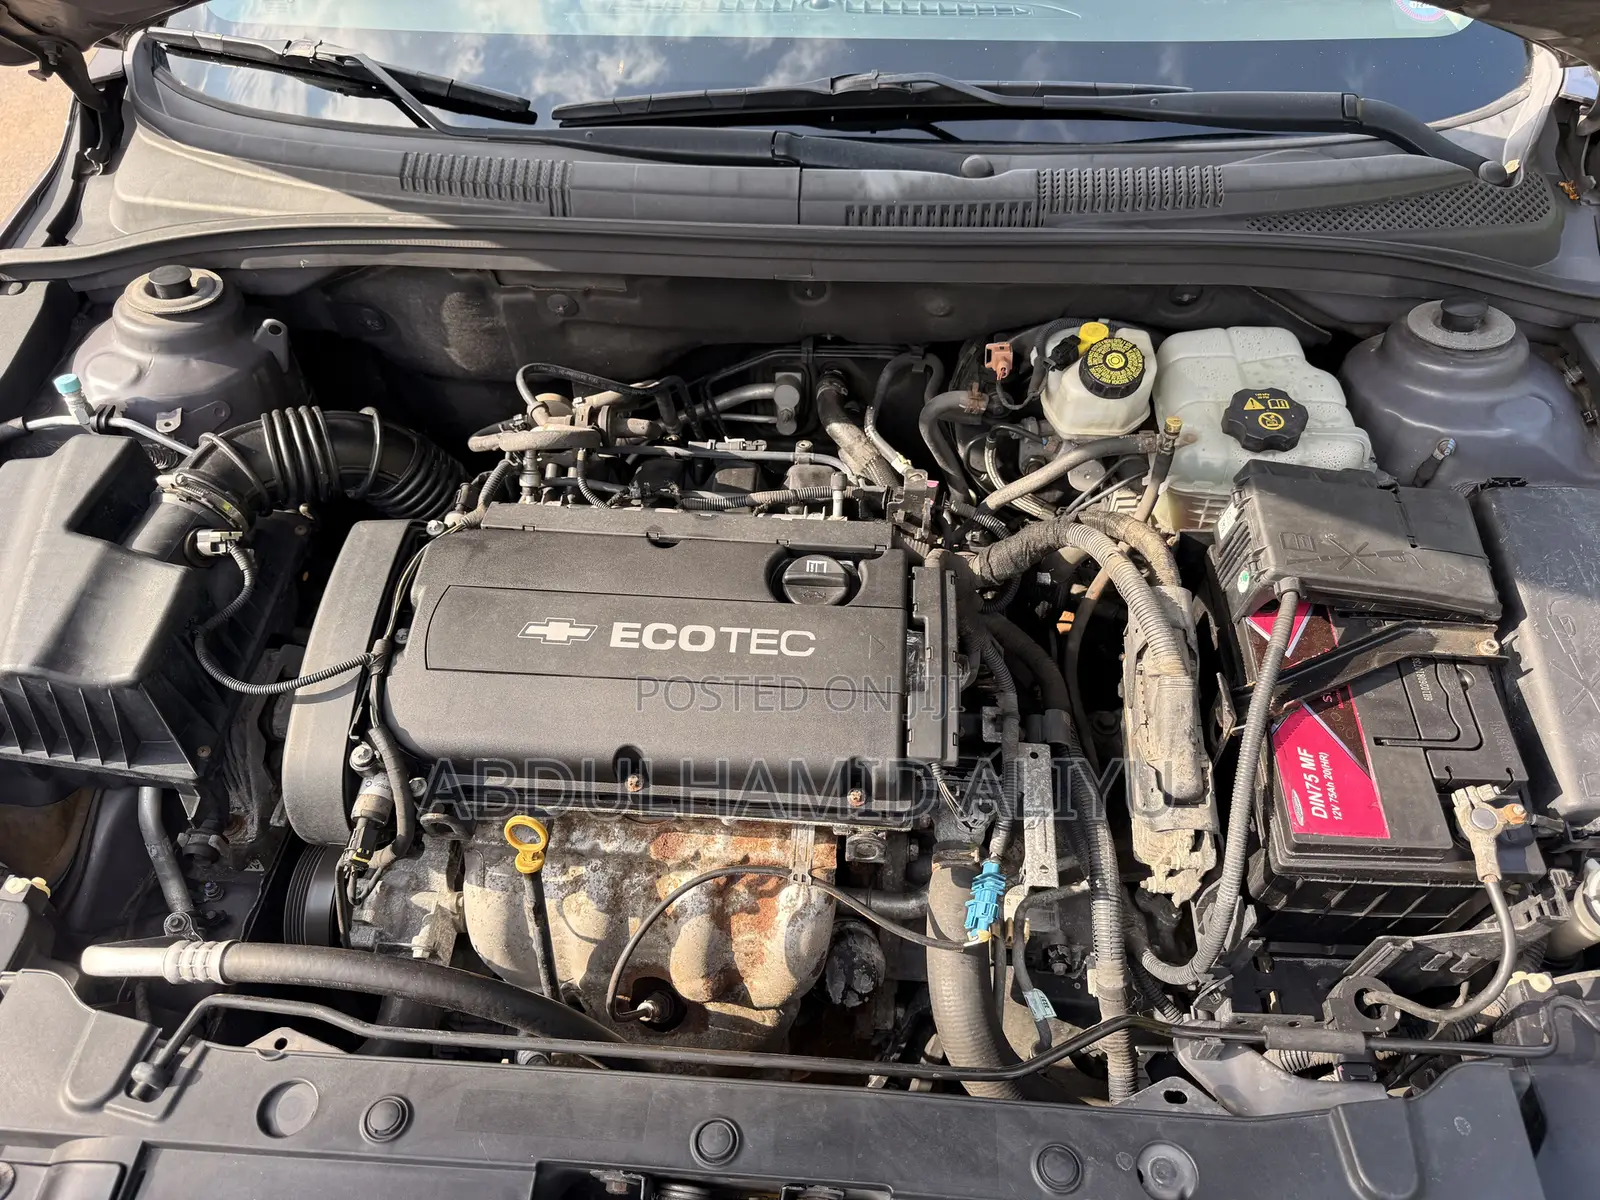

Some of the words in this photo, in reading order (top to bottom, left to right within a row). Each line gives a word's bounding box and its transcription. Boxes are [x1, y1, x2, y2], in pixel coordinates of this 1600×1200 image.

[609, 621, 816, 657] ECOTEC
[1297, 746, 1316, 771] MF
[1318, 752, 1333, 781] 20(HR)
[1303, 773, 1328, 819] DIN75
[1325, 782, 1339, 803] 75Ah
[1330, 804, 1343, 820] 12V
